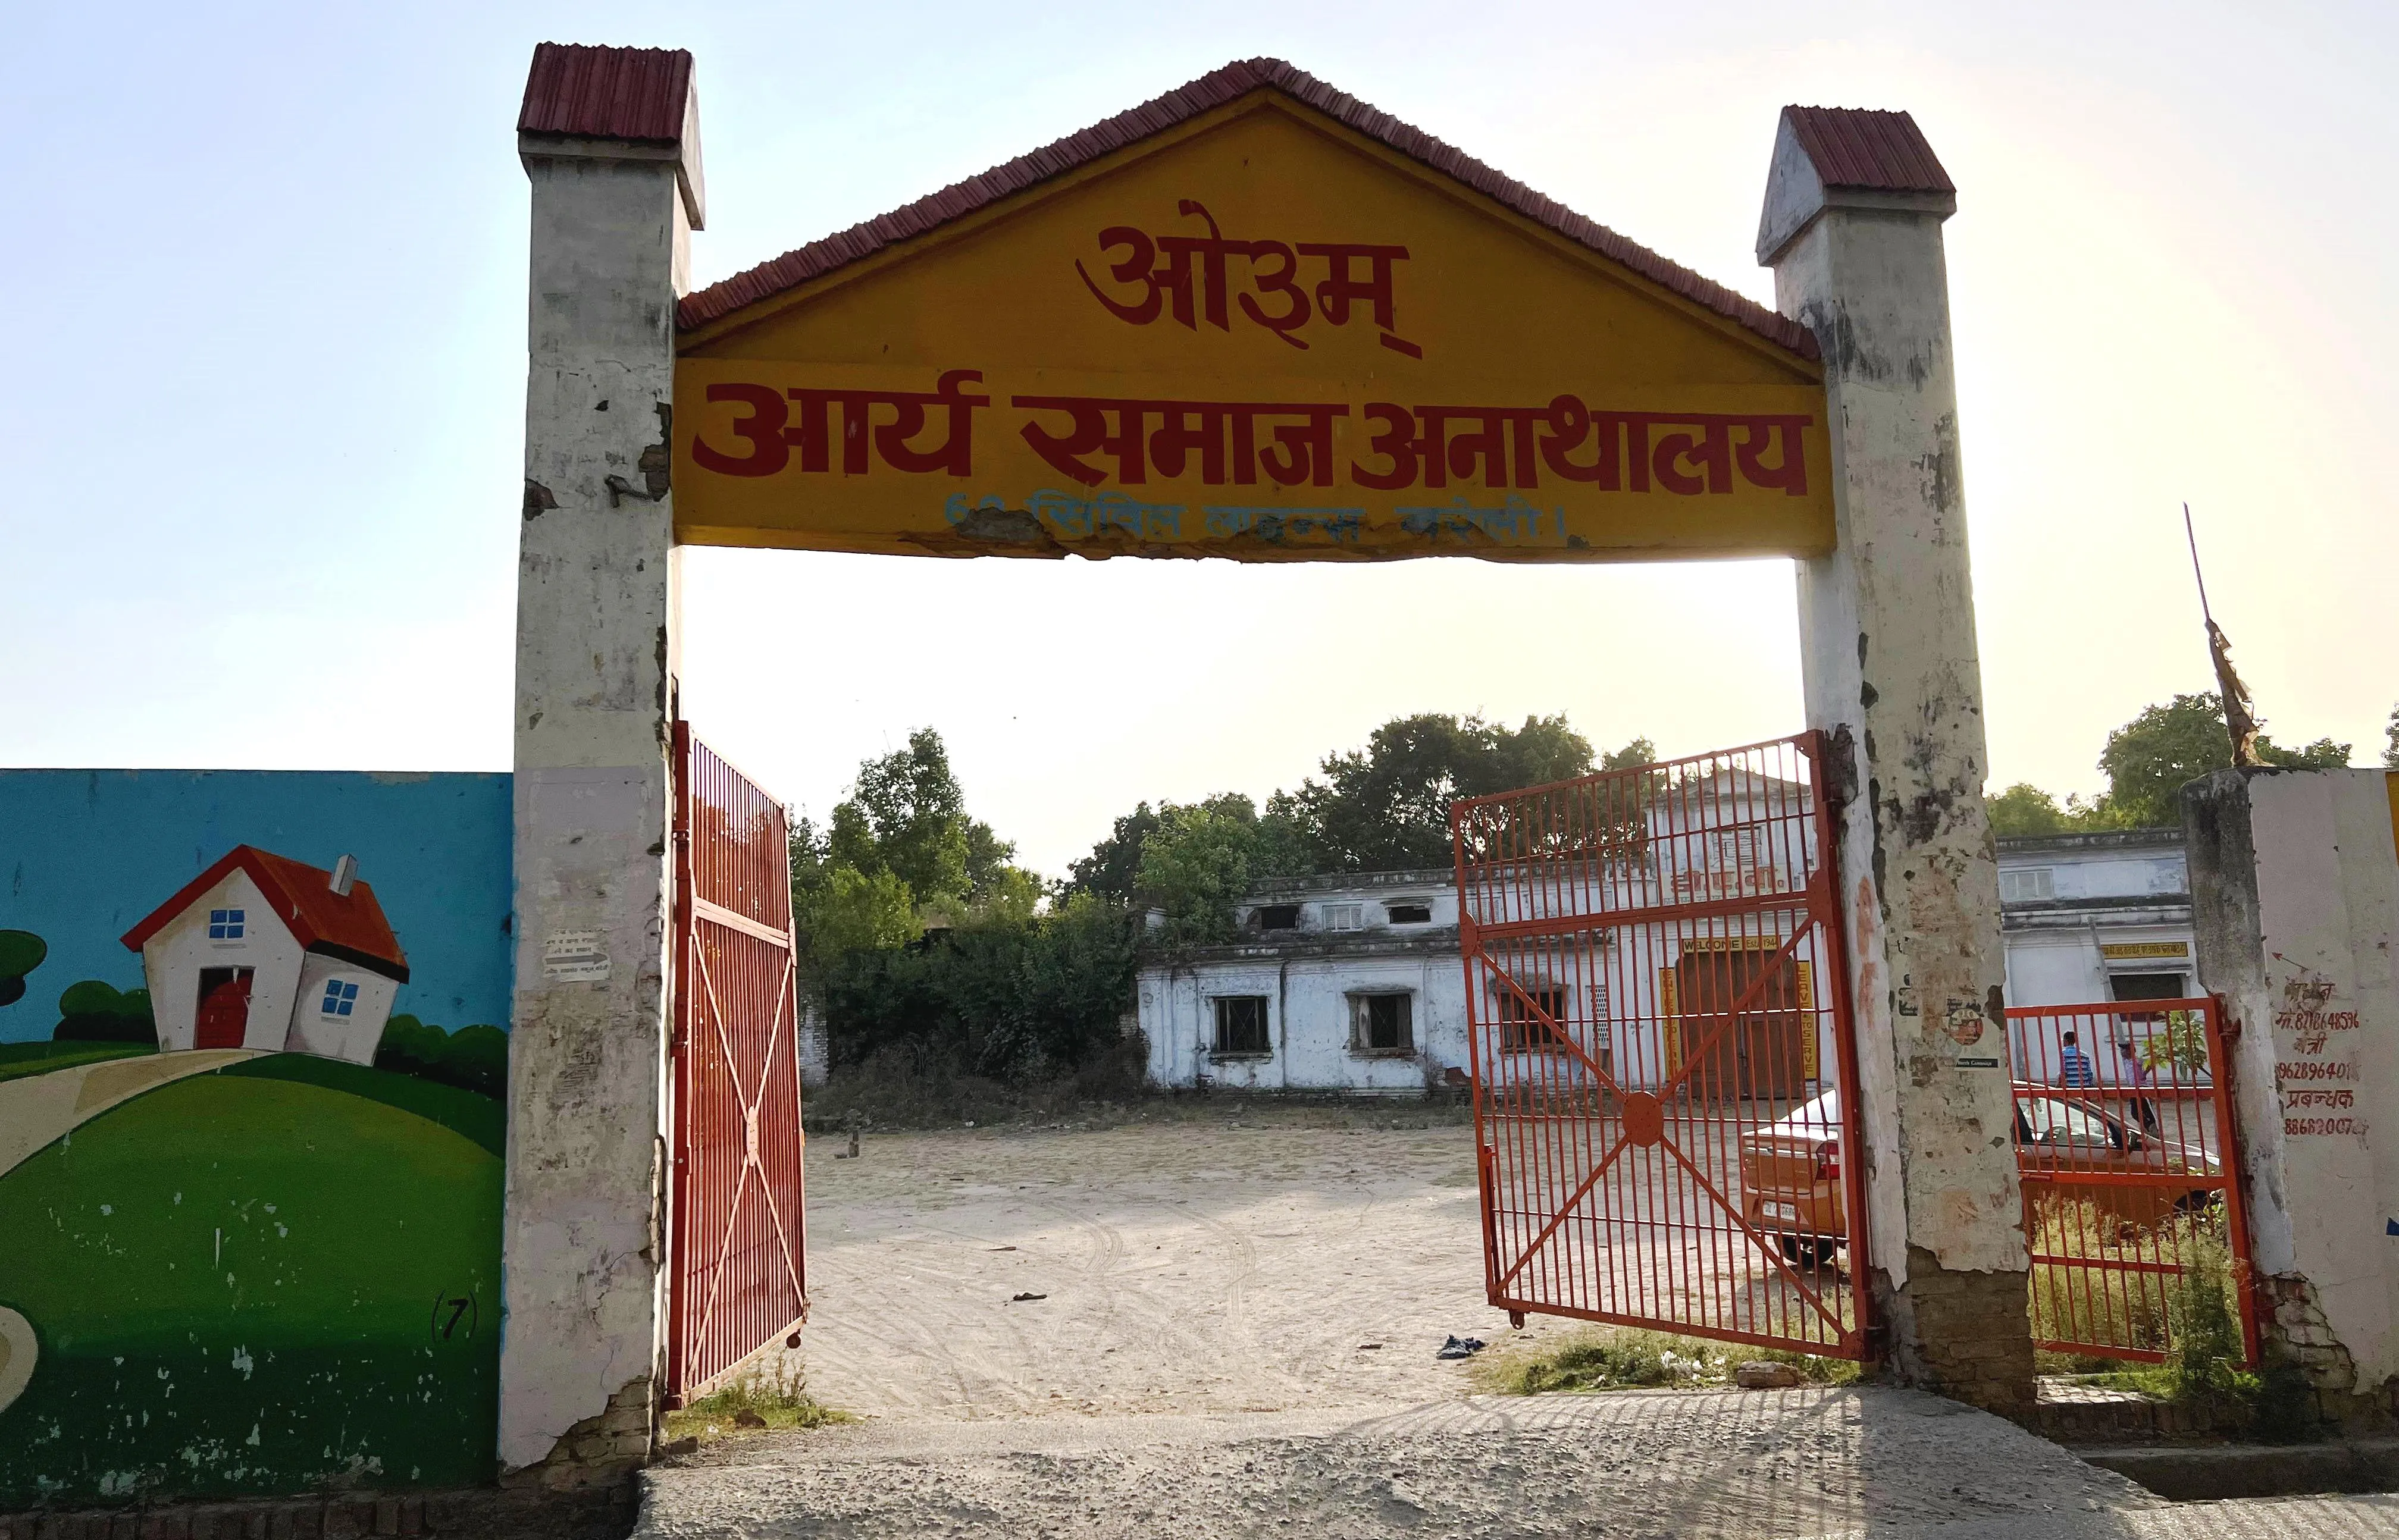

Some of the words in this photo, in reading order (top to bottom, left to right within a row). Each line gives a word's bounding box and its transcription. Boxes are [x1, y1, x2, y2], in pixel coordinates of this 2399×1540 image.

[692, 369, 990, 477] आर्य
[1011, 396, 1349, 487] समाज
[1351, 394, 1814, 496] अनाथालय
[1803, 1030, 1814, 1072] SERVE
